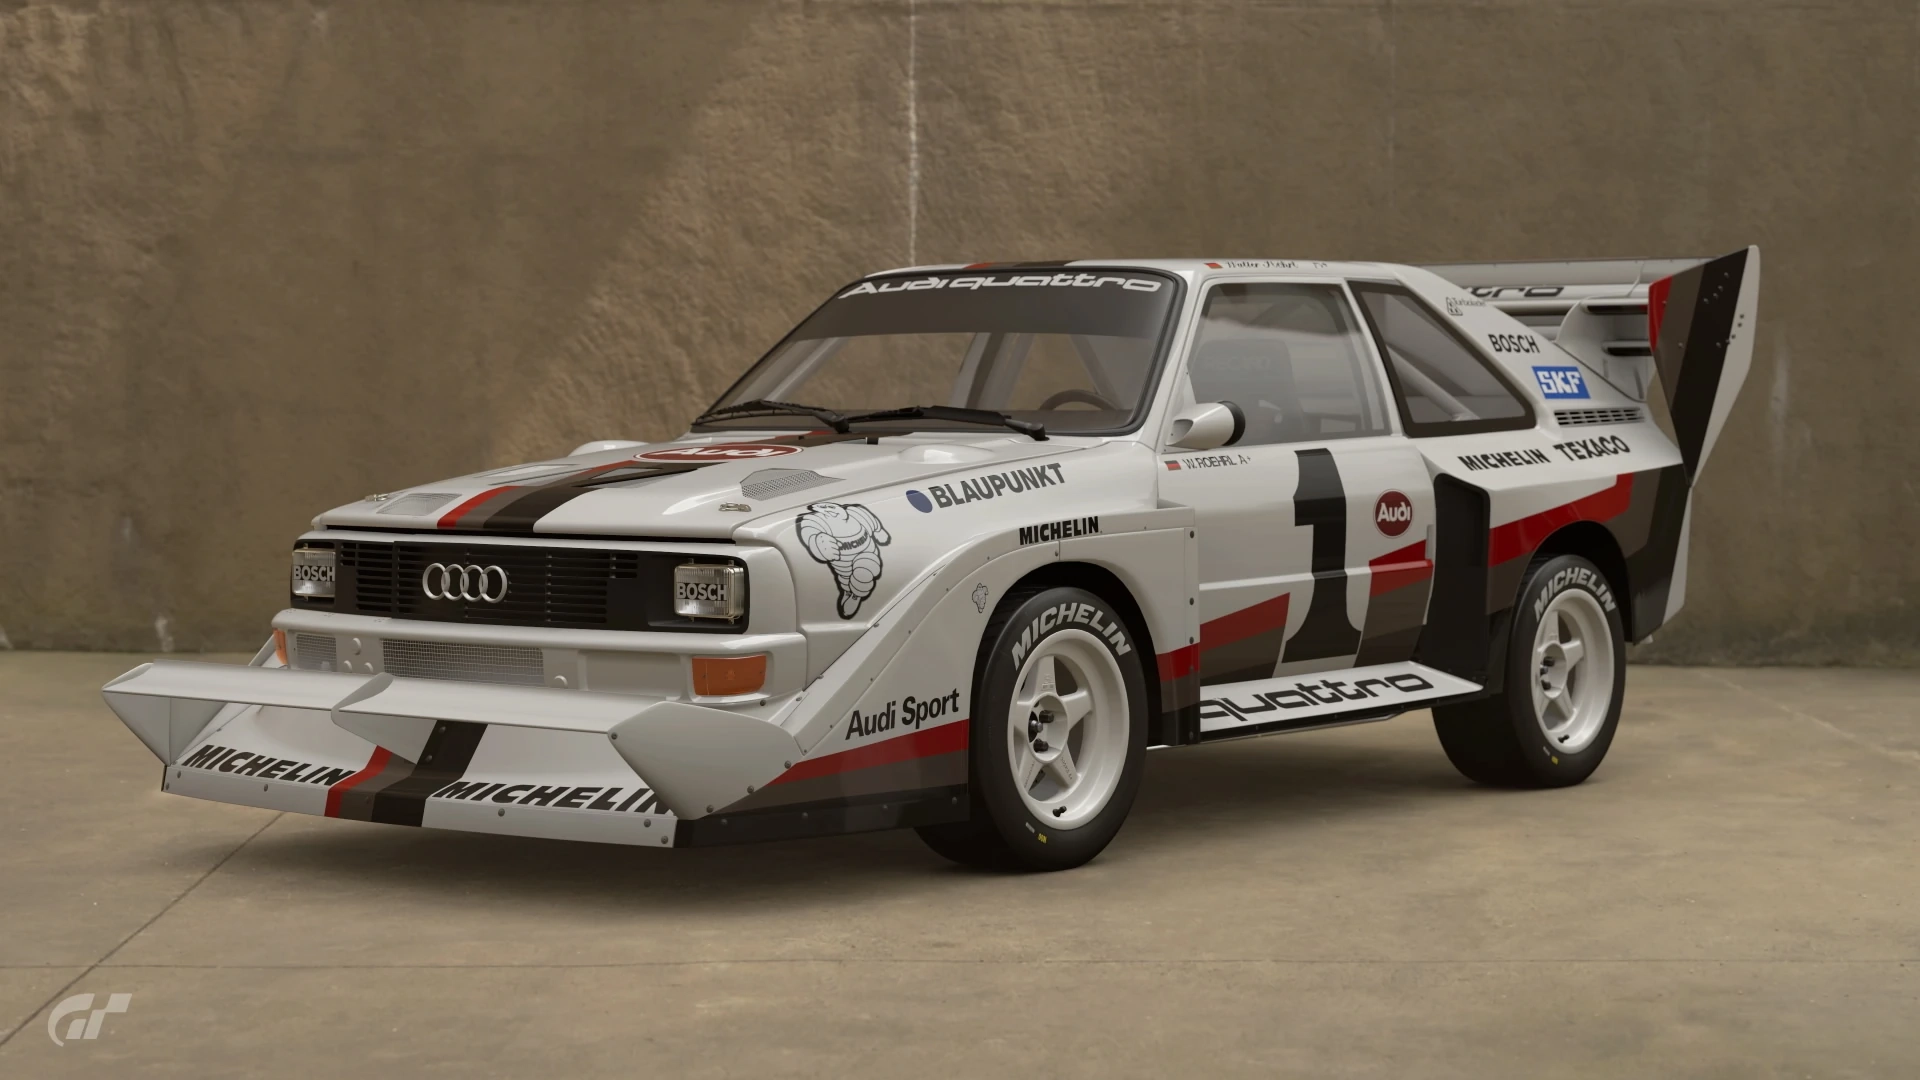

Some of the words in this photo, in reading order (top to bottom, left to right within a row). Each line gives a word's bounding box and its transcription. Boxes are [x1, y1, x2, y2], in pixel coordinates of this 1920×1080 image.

[838, 276, 948, 299] Audi
[949, 273, 1162, 293] quattro
[1488, 334, 1540, 353] BOSCH
[1536, 371, 1582, 394] SKF
[648, 447, 787, 457] Audi
[1457, 448, 1551, 471] MICHELIN
[1553, 435, 1631, 461] TEXACO
[927, 462, 1066, 508] BLAUPUNKT
[1377, 502, 1411, 522] Audi
[1019, 516, 1099, 545] MICHELIN
[1293, 447, 1362, 664] 1
[294, 565, 336, 581] BOSCH
[676, 582, 728, 601] BOSCH
[1534, 566, 1617, 622] MICHELIN
[1011, 602, 1132, 671] MICHELIN
[1200, 673, 1434, 721] quattro
[845, 701, 896, 740] Audi
[901, 688, 960, 729] Sport
[181, 744, 357, 786] MICHELIN
